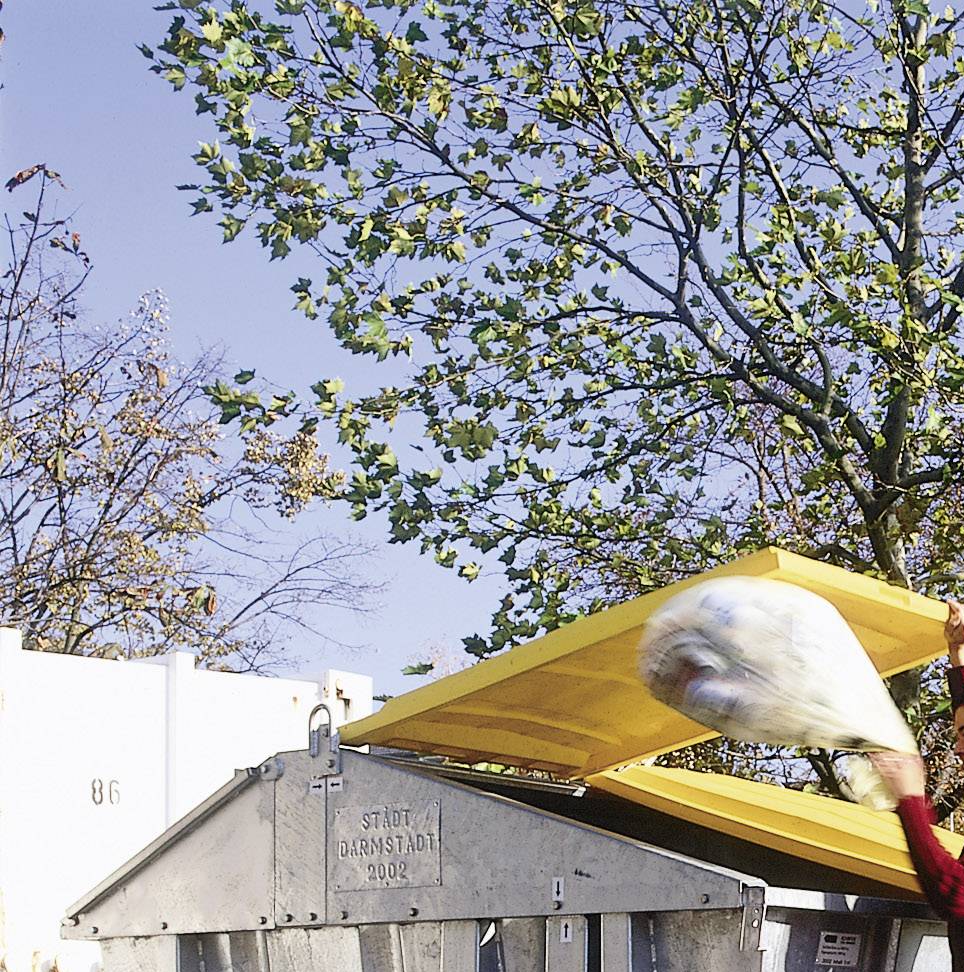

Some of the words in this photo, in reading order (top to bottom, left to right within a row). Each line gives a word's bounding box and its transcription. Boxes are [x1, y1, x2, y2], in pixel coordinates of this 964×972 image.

[91, 778, 120, 805] 86
[361, 809, 410, 831] STADT
[338, 832, 435, 860] DARMSTADT
[366, 861, 409, 882] 2002
